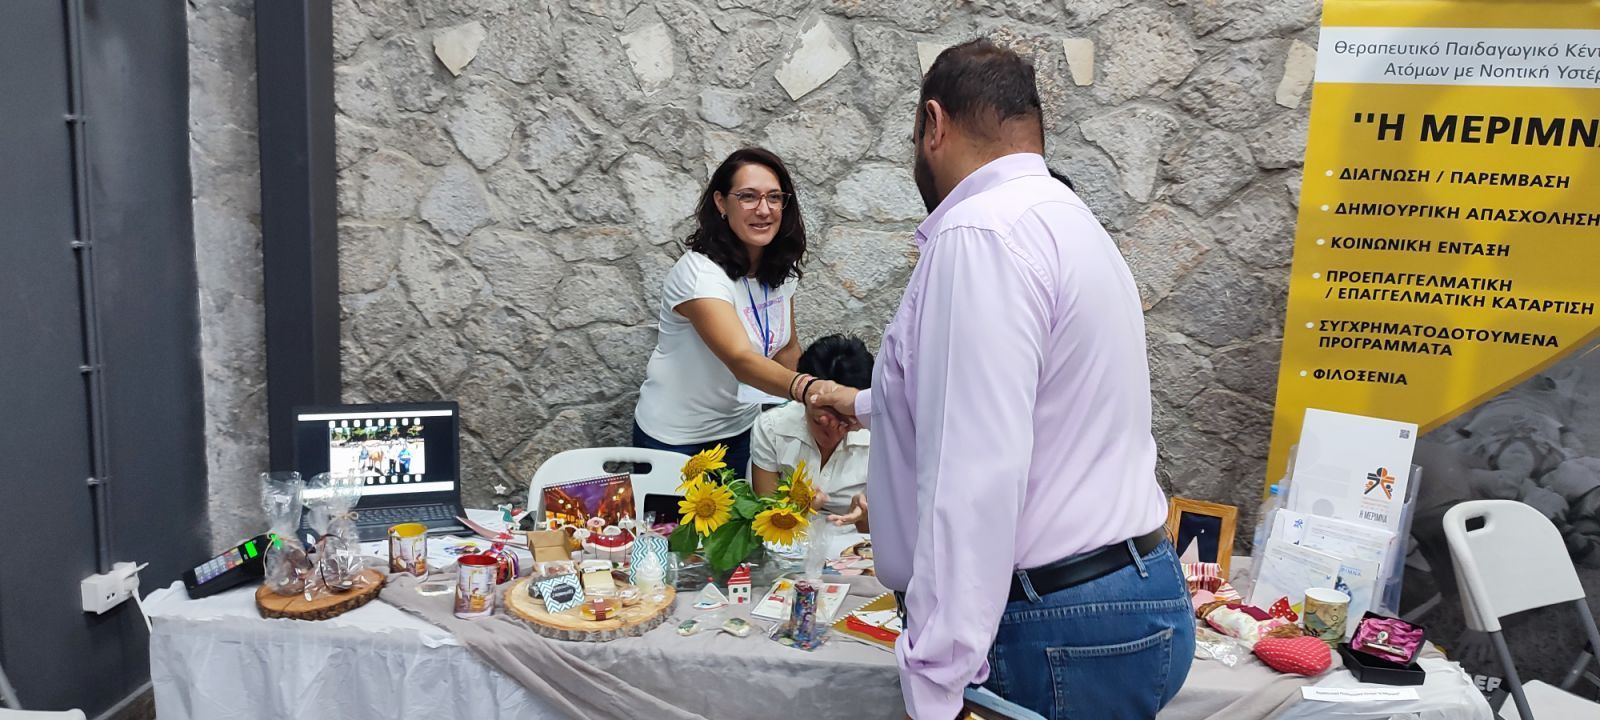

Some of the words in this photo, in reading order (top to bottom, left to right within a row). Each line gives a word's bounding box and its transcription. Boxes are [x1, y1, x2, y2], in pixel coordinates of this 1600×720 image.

[1334, 40, 1440, 57] Θεραπευτικό
[1445, 41, 1559, 61] Παιδαγωγικό
[1383, 62, 1450, 80] Ατόμων
[1453, 66, 1474, 81] με
[1479, 64, 1549, 79] Νοητική
[1420, 114, 1600, 148] ΜΕΡΙΜΝ
[1339, 167, 1430, 182] ΔΙΑΓΝΩΣΗ
[1436, 170, 1444, 183] /
[1450, 171, 1570, 189] ΠΑΡΕΜΒΑΣΗ
[1335, 202, 1460, 219] ΔΗΜΙΟΥΡΓΙΚΗ
[1466, 207, 1600, 227] ΑΠΑΣΧΟΛΗΣΗ
[1331, 236, 1431, 253] ΚΟΙΝΩΝΙΚΗ
[1437, 241, 1510, 257] ΕΝΤΑΞΗ
[1326, 270, 1513, 292] ΠΡΟΕΠΑΓΓΕΛΜΑΤΙΚΗ
[1325, 287, 1333, 299] /
[1338, 287, 1486, 307] ΕΠΑΓΓΕΛΜΑΤΙΚΗ
[1492, 296, 1594, 315] ΚΑΤΑΡΤΙΣΗ
[1319, 319, 1559, 348] ΣΥΓΧΡΗΜΑΤΟΔΟΤΟΥΜΕΝΑ
[1319, 336, 1453, 356] ΠΡΟΓΡΑΜΜΑΤΑ
[1313, 368, 1408, 386] ΦΙΛΟΞΕΝΙΑ
